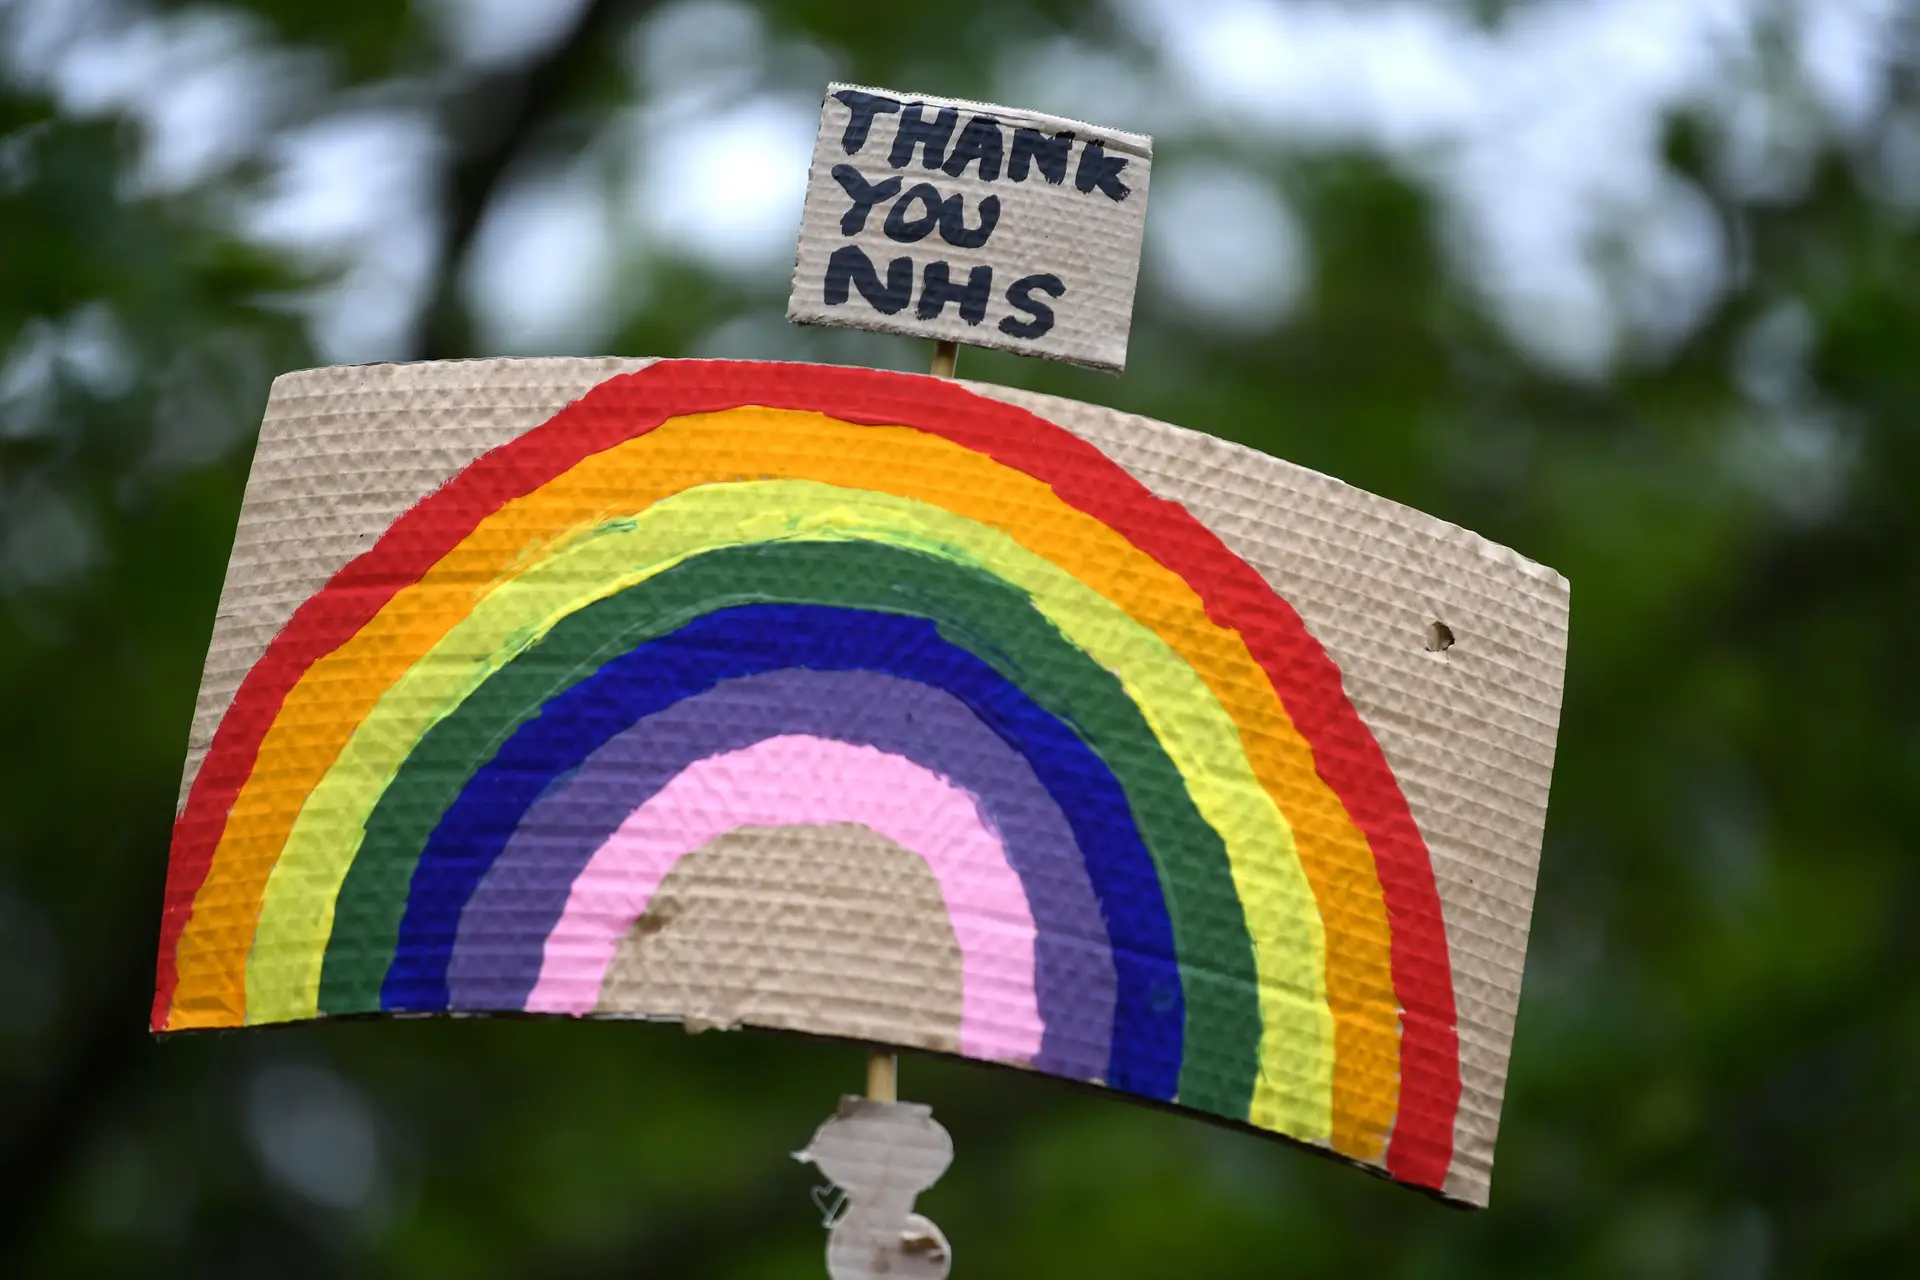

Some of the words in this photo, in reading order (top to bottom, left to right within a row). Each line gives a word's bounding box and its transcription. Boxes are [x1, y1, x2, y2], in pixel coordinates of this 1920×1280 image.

[832, 89, 1132, 203] THANK
[831, 163, 1001, 249] YOU
[824, 245, 1067, 339] NHS
